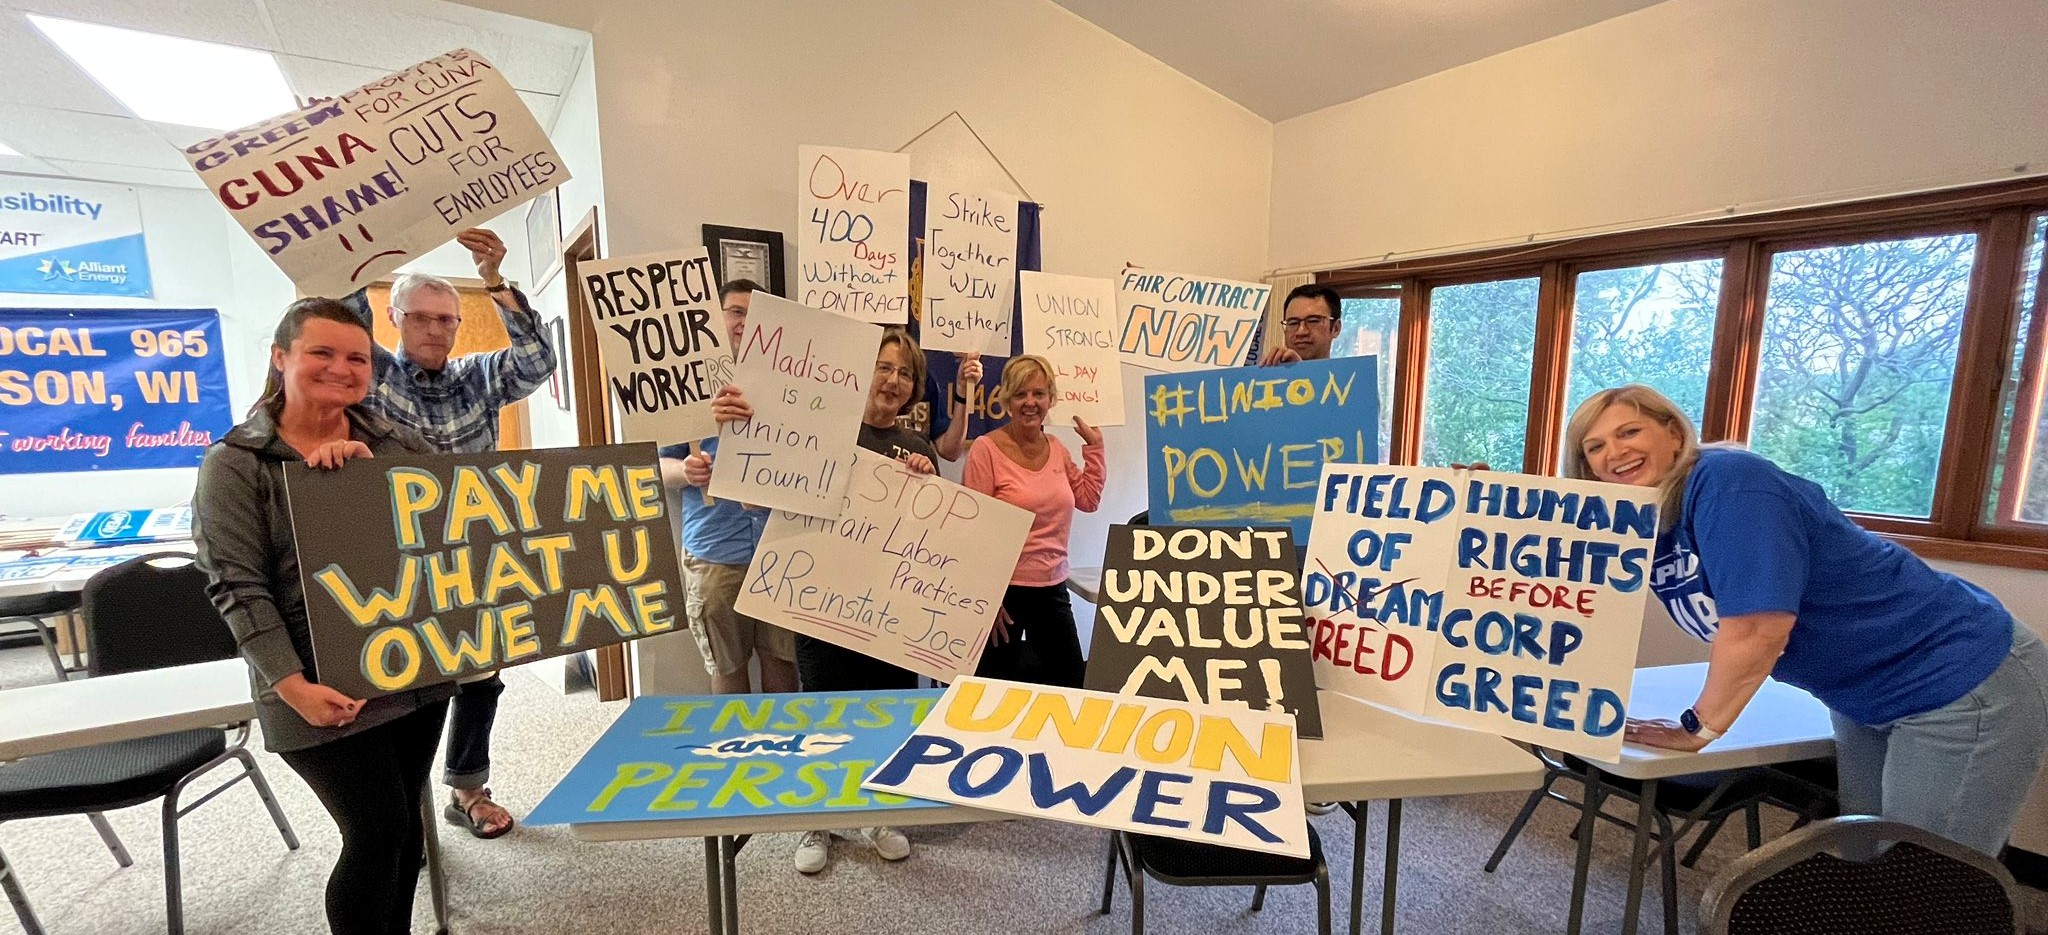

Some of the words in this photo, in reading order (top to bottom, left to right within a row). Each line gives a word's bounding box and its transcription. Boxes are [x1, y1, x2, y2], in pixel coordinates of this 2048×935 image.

[355, 91, 411, 123] FOR
[415, 59, 492, 96] CUNA
[389, 93, 497, 165] CUTS
[219, 132, 377, 210] CUNA
[447, 135, 514, 176] FOR
[809, 154, 904, 203] Over
[253, 160, 409, 255] SHAME!
[433, 151, 556, 225] EMPLOYEES
[811, 207, 873, 244] 400
[942, 193, 1011, 233] Strike
[0, 232, 42, 246] ART
[854, 241, 897, 270] Days
[929, 228, 1009, 270] Together
[78, 261, 127, 274] Alliant
[79, 272, 126, 285] Energy
[586, 257, 711, 320] RESPECT
[803, 261, 898, 284] Without
[949, 272, 997, 299] WIN
[1122, 273, 1164, 294] FAIR
[1162, 276, 1269, 311] CONTRACT
[805, 290, 908, 313] CONTRACT
[928, 298, 1011, 340] Together!
[1036, 293, 1100, 318] UNION
[130, 329, 208, 357] 965
[609, 309, 720, 364] YOUR
[741, 324, 860, 392] Madison
[1046, 326, 1113, 349] STRONG!
[1119, 304, 1257, 367] NOW
[135, 371, 200, 404] WI
[782, 384, 798, 405] is
[810, 396, 826, 411] a
[1074, 365, 1097, 383] DAY
[1149, 370, 1356, 428] #UNION
[12, 427, 112, 457] working
[126, 421, 213, 448] families
[386, 461, 543, 549] PAY
[563, 464, 665, 523] ME
[860, 463, 980, 530] STOP
[1324, 474, 1456, 524] FIELD
[1466, 480, 1658, 539] HUMAN
[882, 517, 958, 570] Labor
[1133, 526, 1288, 561] DON'T
[1347, 529, 1412, 571] OF
[1458, 527, 1648, 593] RIGHTS
[313, 533, 577, 630] WHAT
[603, 526, 651, 585] U
[890, 560, 989, 615] Practices
[1104, 569, 1299, 607] UNDER
[1305, 571, 1444, 632] DREAM
[1467, 576, 1597, 617] BEFORE
[360, 600, 541, 691] OWE
[560, 580, 675, 649] ME
[1101, 605, 1310, 650] VALUE
[1306, 616, 1414, 681] REED
[1442, 608, 1583, 665] CORP
[1119, 654, 1286, 714] ME!
[1435, 663, 1625, 737] GREED
[641, 697, 943, 737] INSIST
[944, 681, 1294, 784] UNION
[585, 760, 912, 812] PERSI
[868, 734, 1288, 844] POWER
